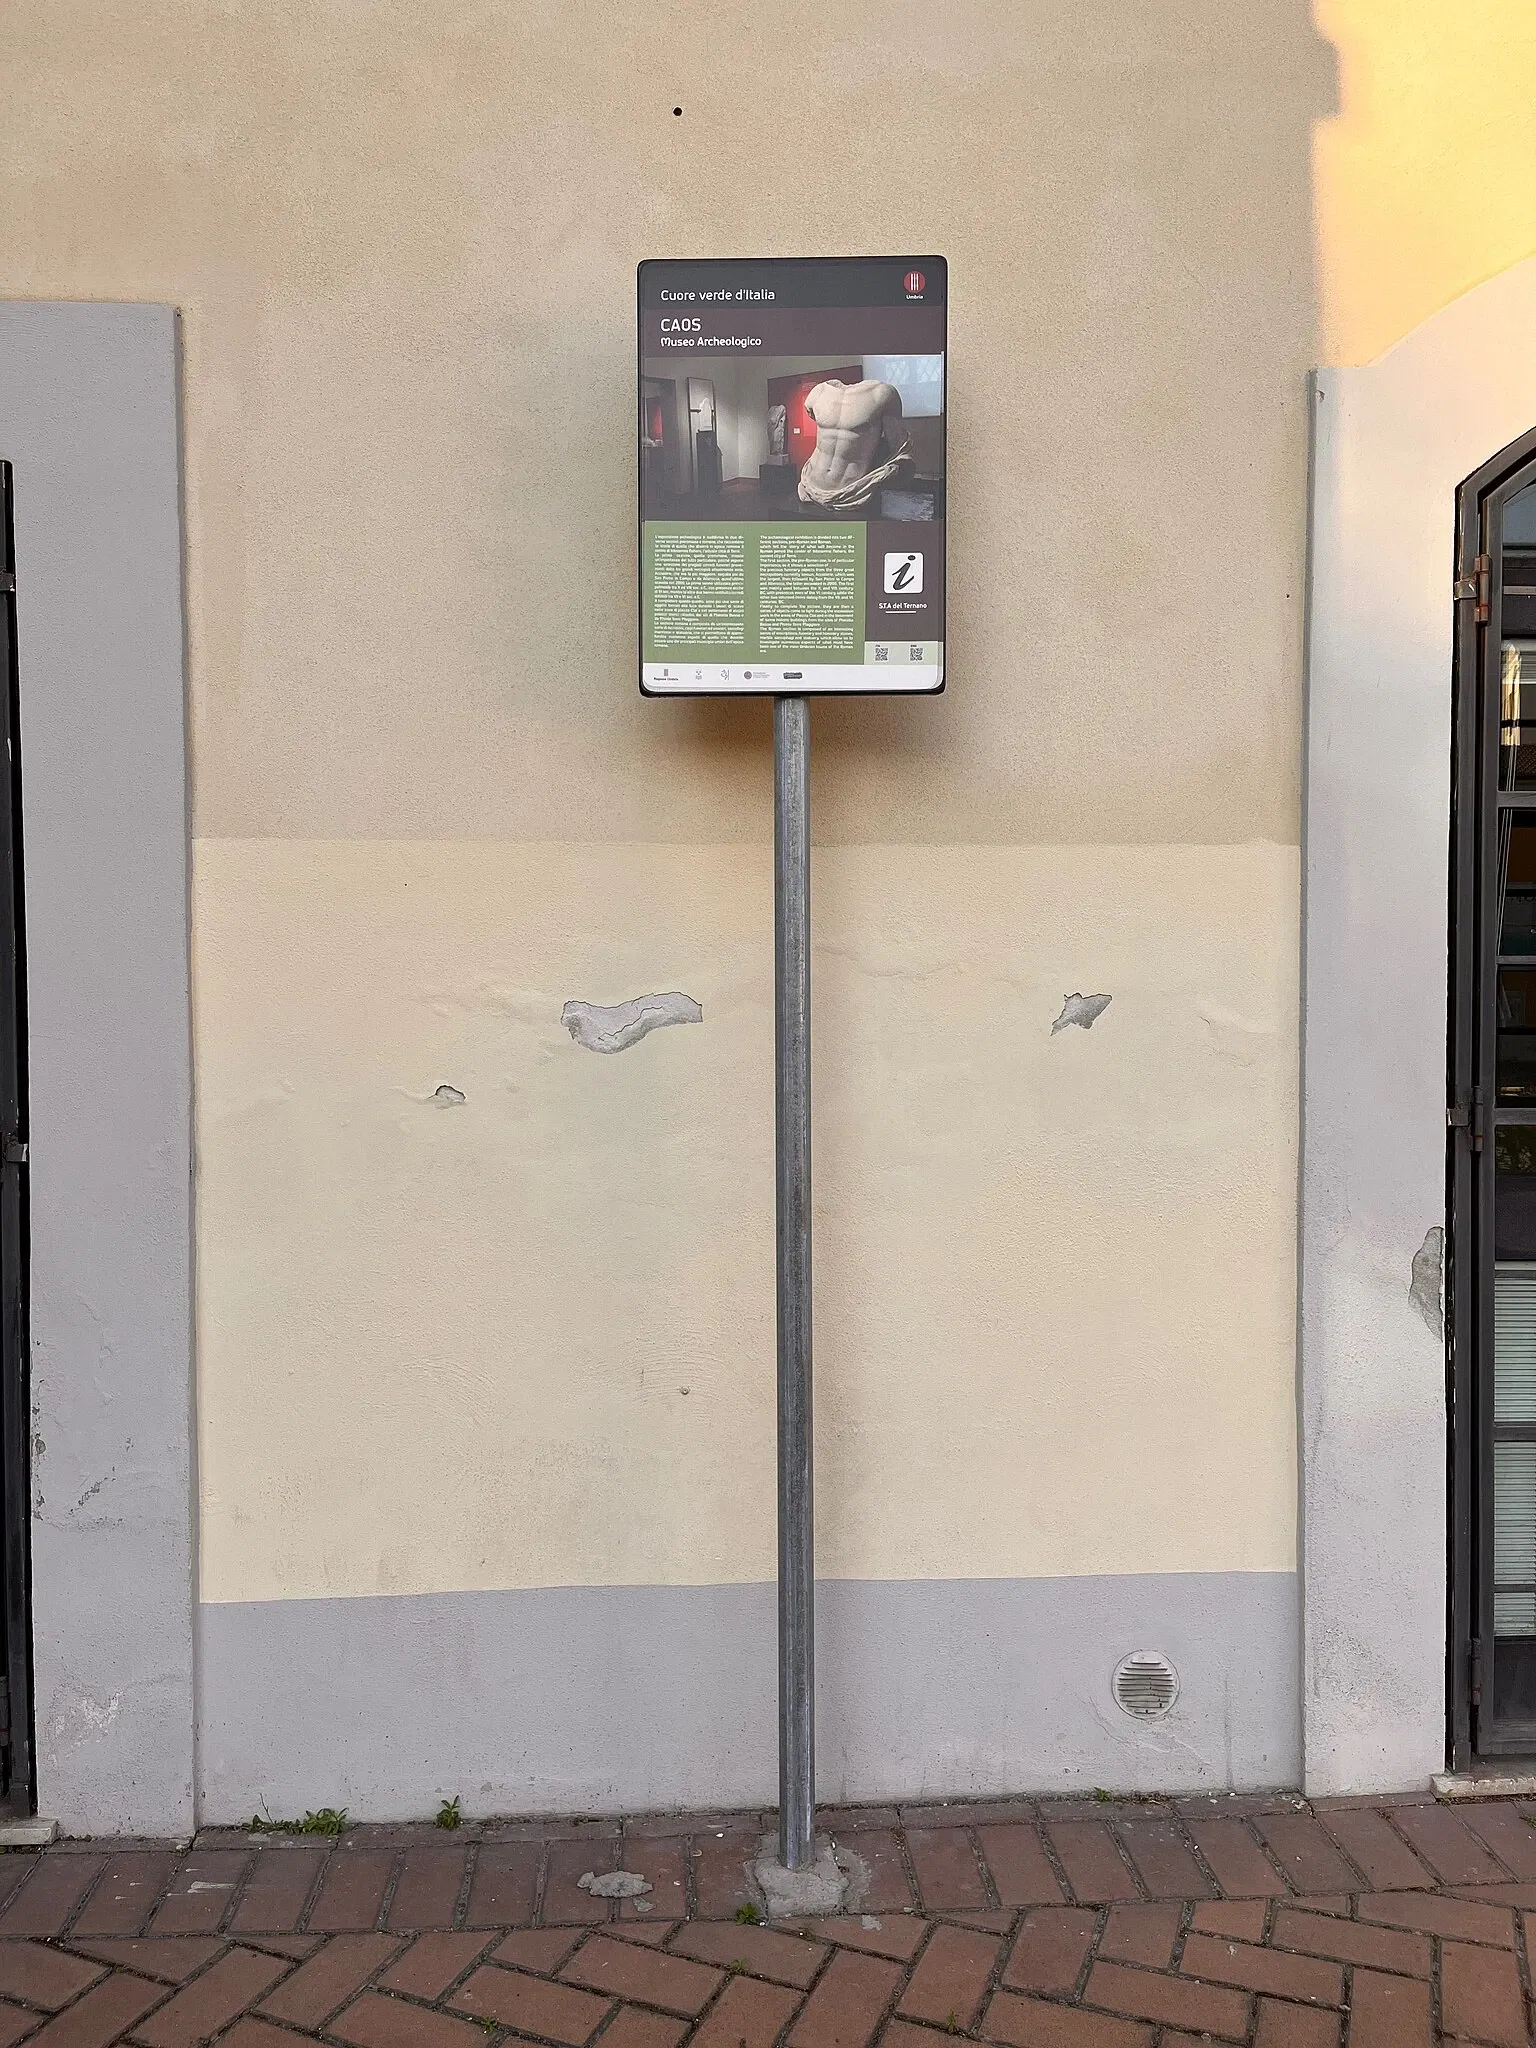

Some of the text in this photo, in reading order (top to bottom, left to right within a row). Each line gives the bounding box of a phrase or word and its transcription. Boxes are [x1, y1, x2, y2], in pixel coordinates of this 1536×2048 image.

[660, 289, 775, 301] Cuore verde d'Italia
[660, 318, 701, 332] CAOS
[660, 336, 762, 348] Museo Archeologico
